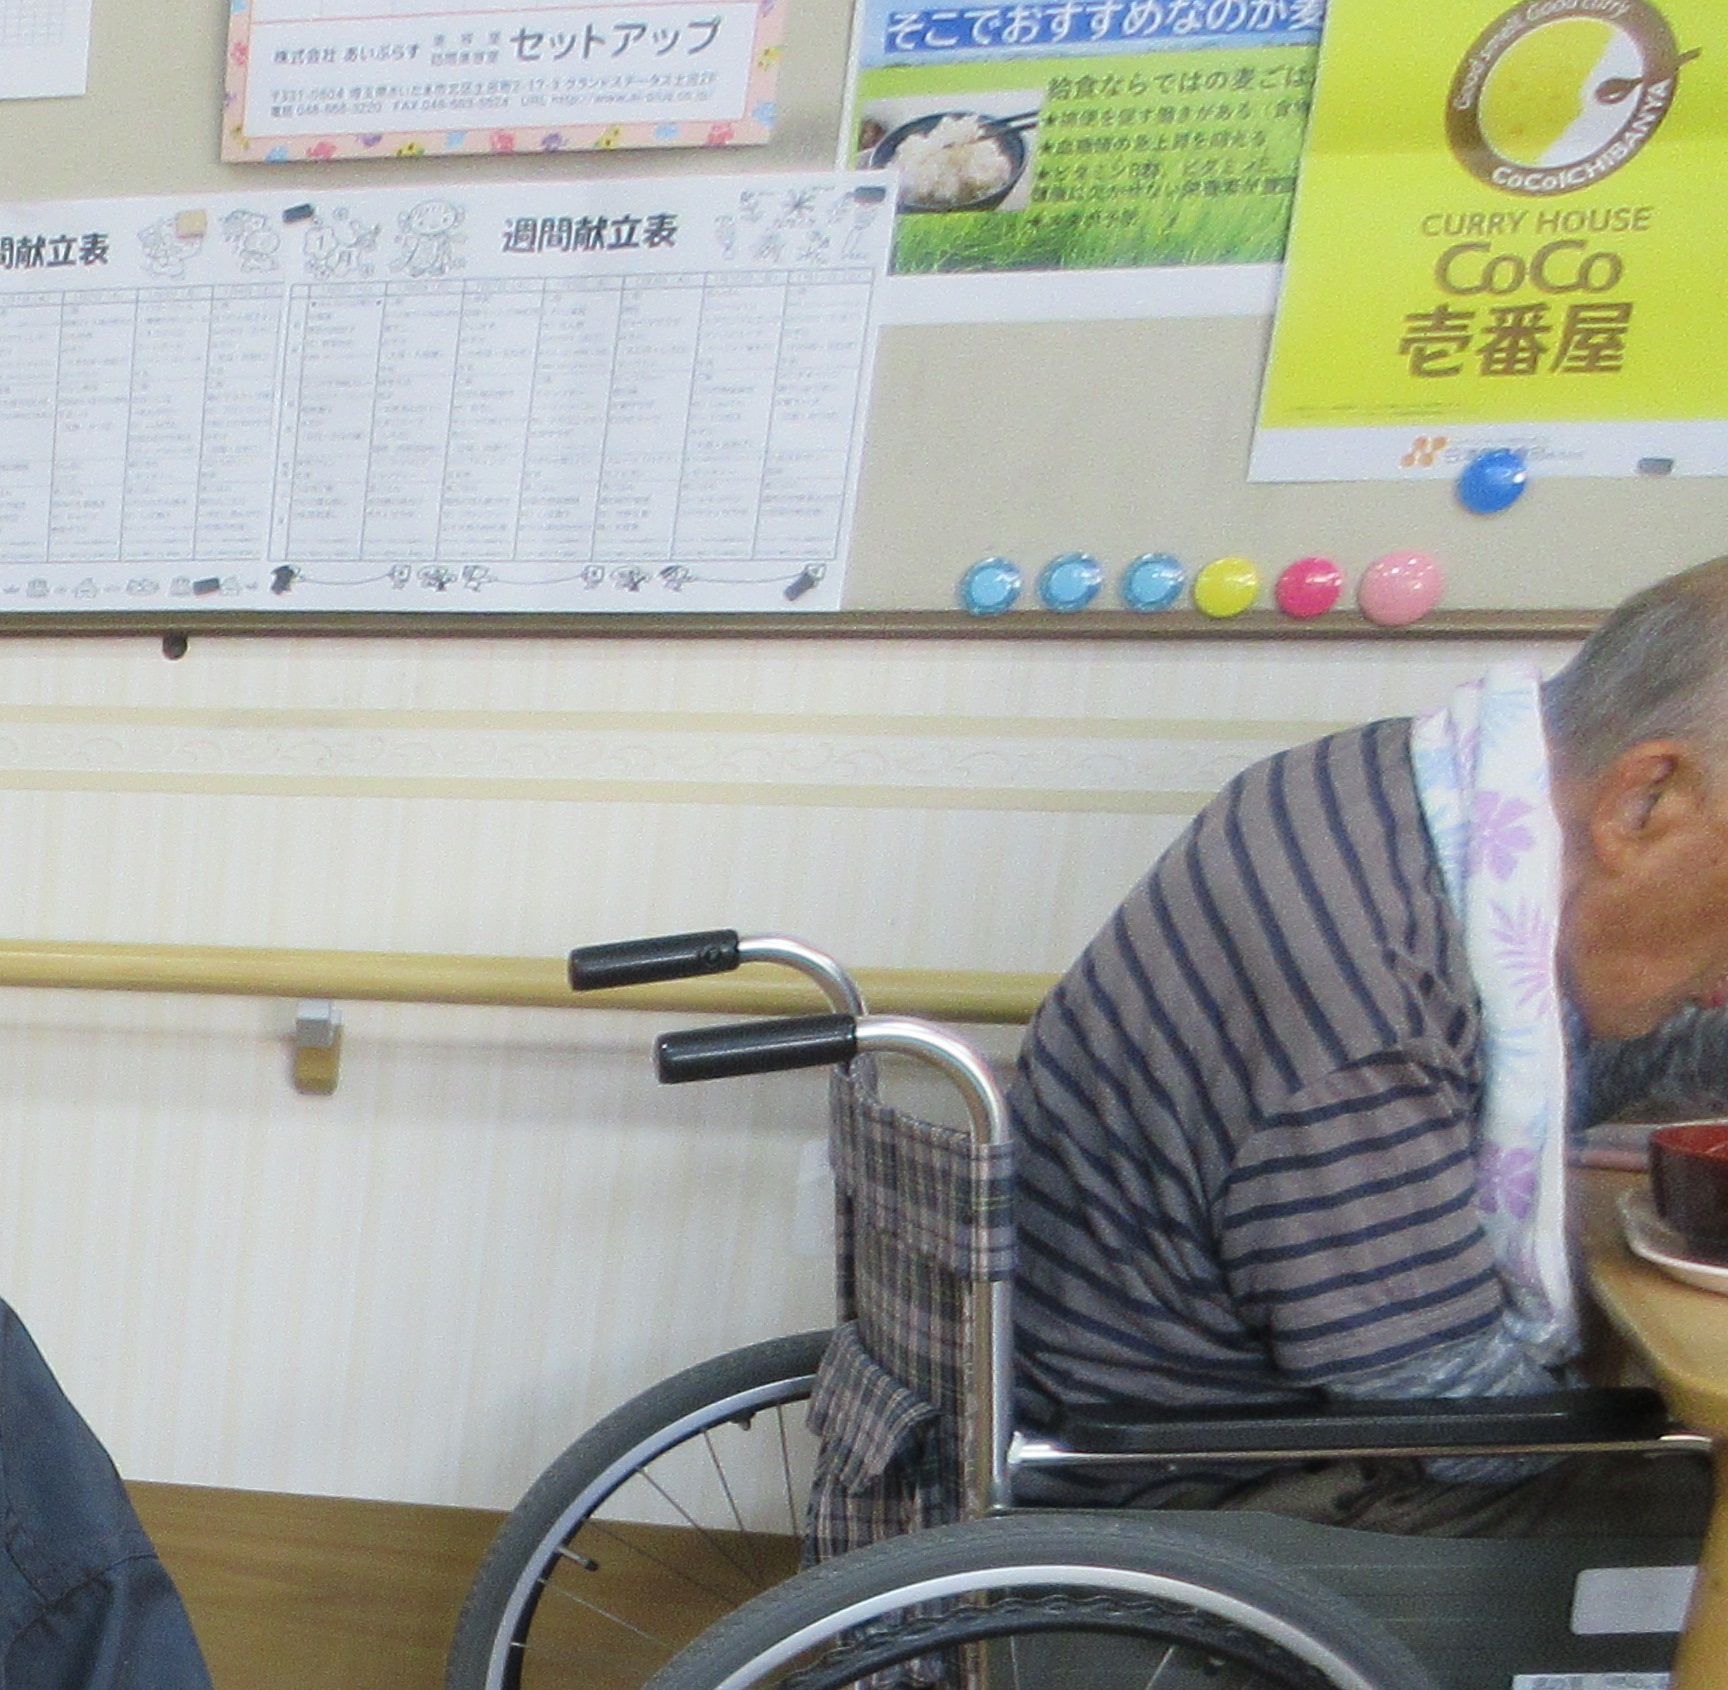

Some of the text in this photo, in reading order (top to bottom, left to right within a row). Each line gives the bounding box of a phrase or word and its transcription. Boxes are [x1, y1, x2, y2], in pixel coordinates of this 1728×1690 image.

[511, 15, 722, 63] セットアップ
[503, 212, 679, 253] 週間献立表
[1421, 206, 1654, 237] CURRY HOUSE
[1435, 238, 1624, 296] CoCo
[1397, 301, 1634, 378] 壱番屋
